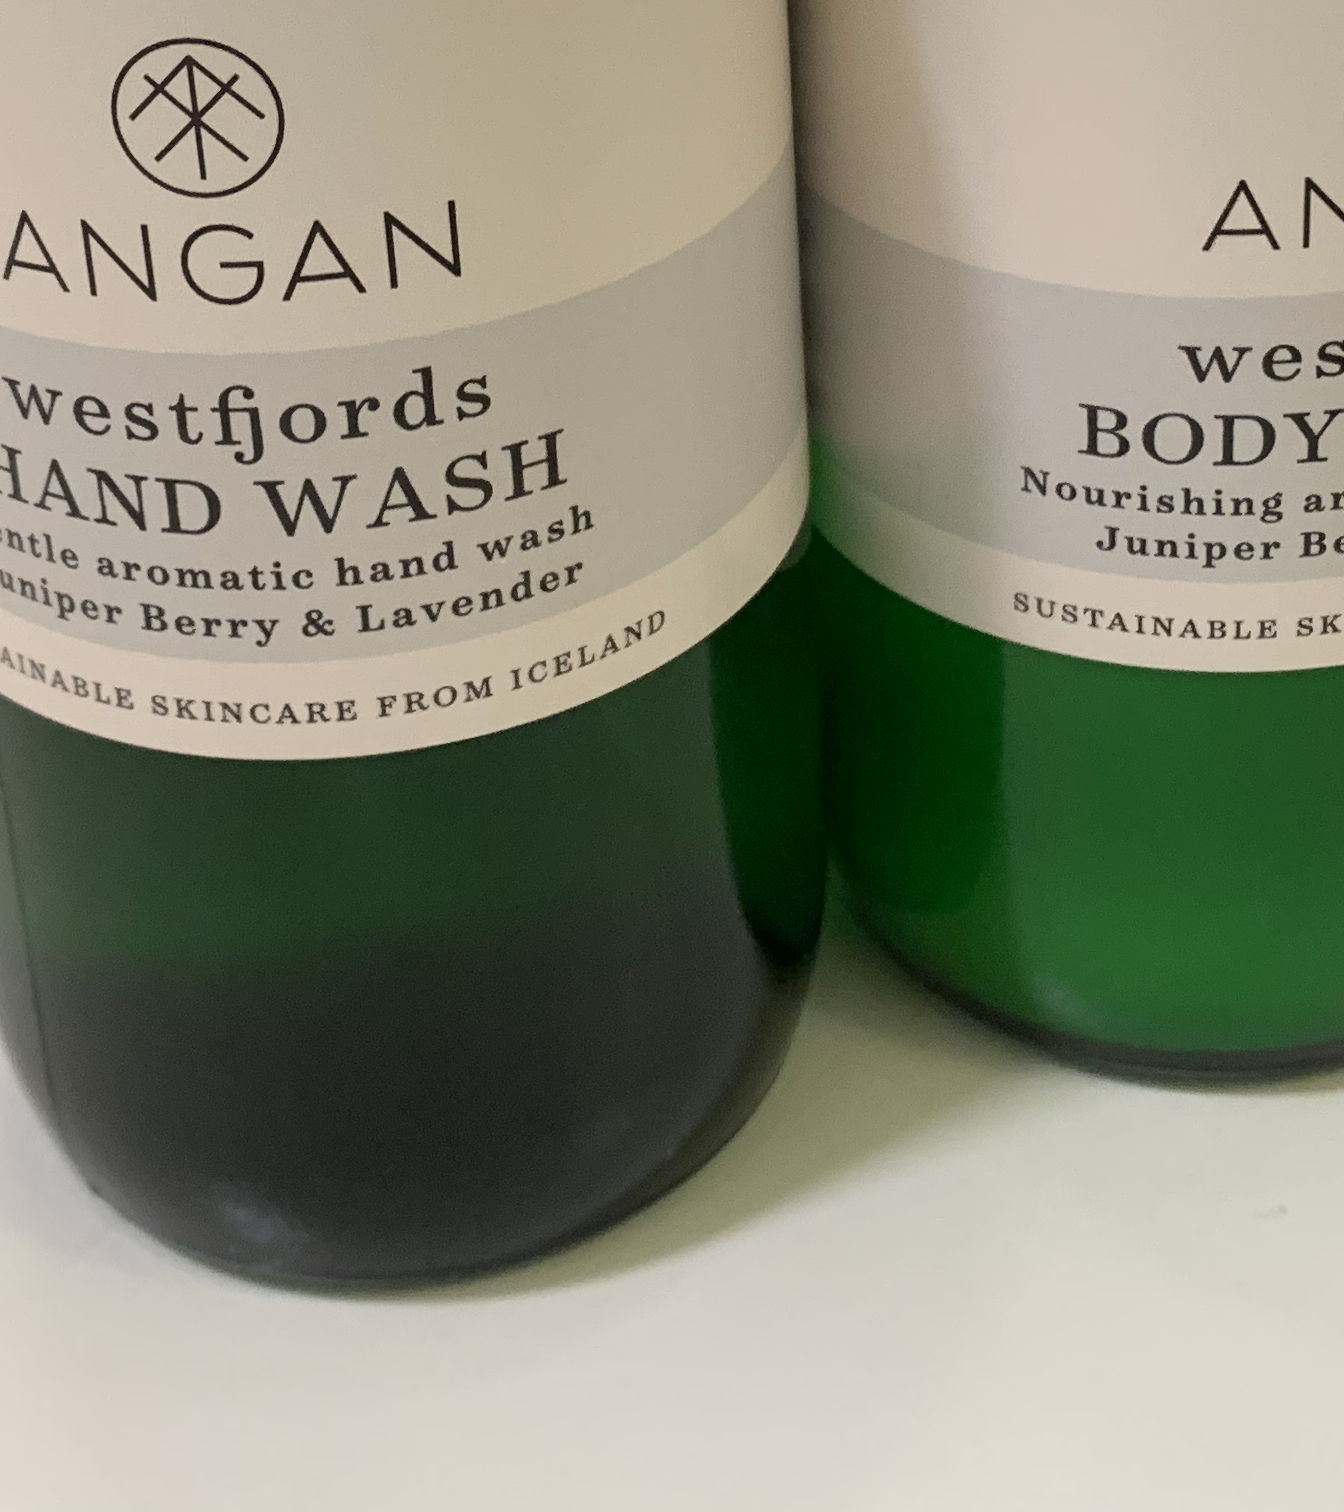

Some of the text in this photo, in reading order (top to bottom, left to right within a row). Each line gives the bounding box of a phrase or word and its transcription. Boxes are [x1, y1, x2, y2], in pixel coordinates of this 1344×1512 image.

[3, 199, 462, 305] ANGAN
[2, 365, 493, 465] westfjords
[254, 428, 568, 537] WASH
[1019, 465, 1284, 522] Nourishing
[96, 559, 314, 591] aromatic
[335, 541, 459, 587] hand
[478, 504, 595, 563] wash
[1095, 525, 1281, 569] Juniper
[140, 602, 280, 646] Berry
[302, 609, 337, 637] &
[357, 557, 585, 633] Lavender
[1013, 591, 1278, 641] SUSTAINABLE
[150, 694, 358, 725] SKINCARE
[376, 676, 495, 719] FROM
[509, 608, 667, 693] ICELAND
